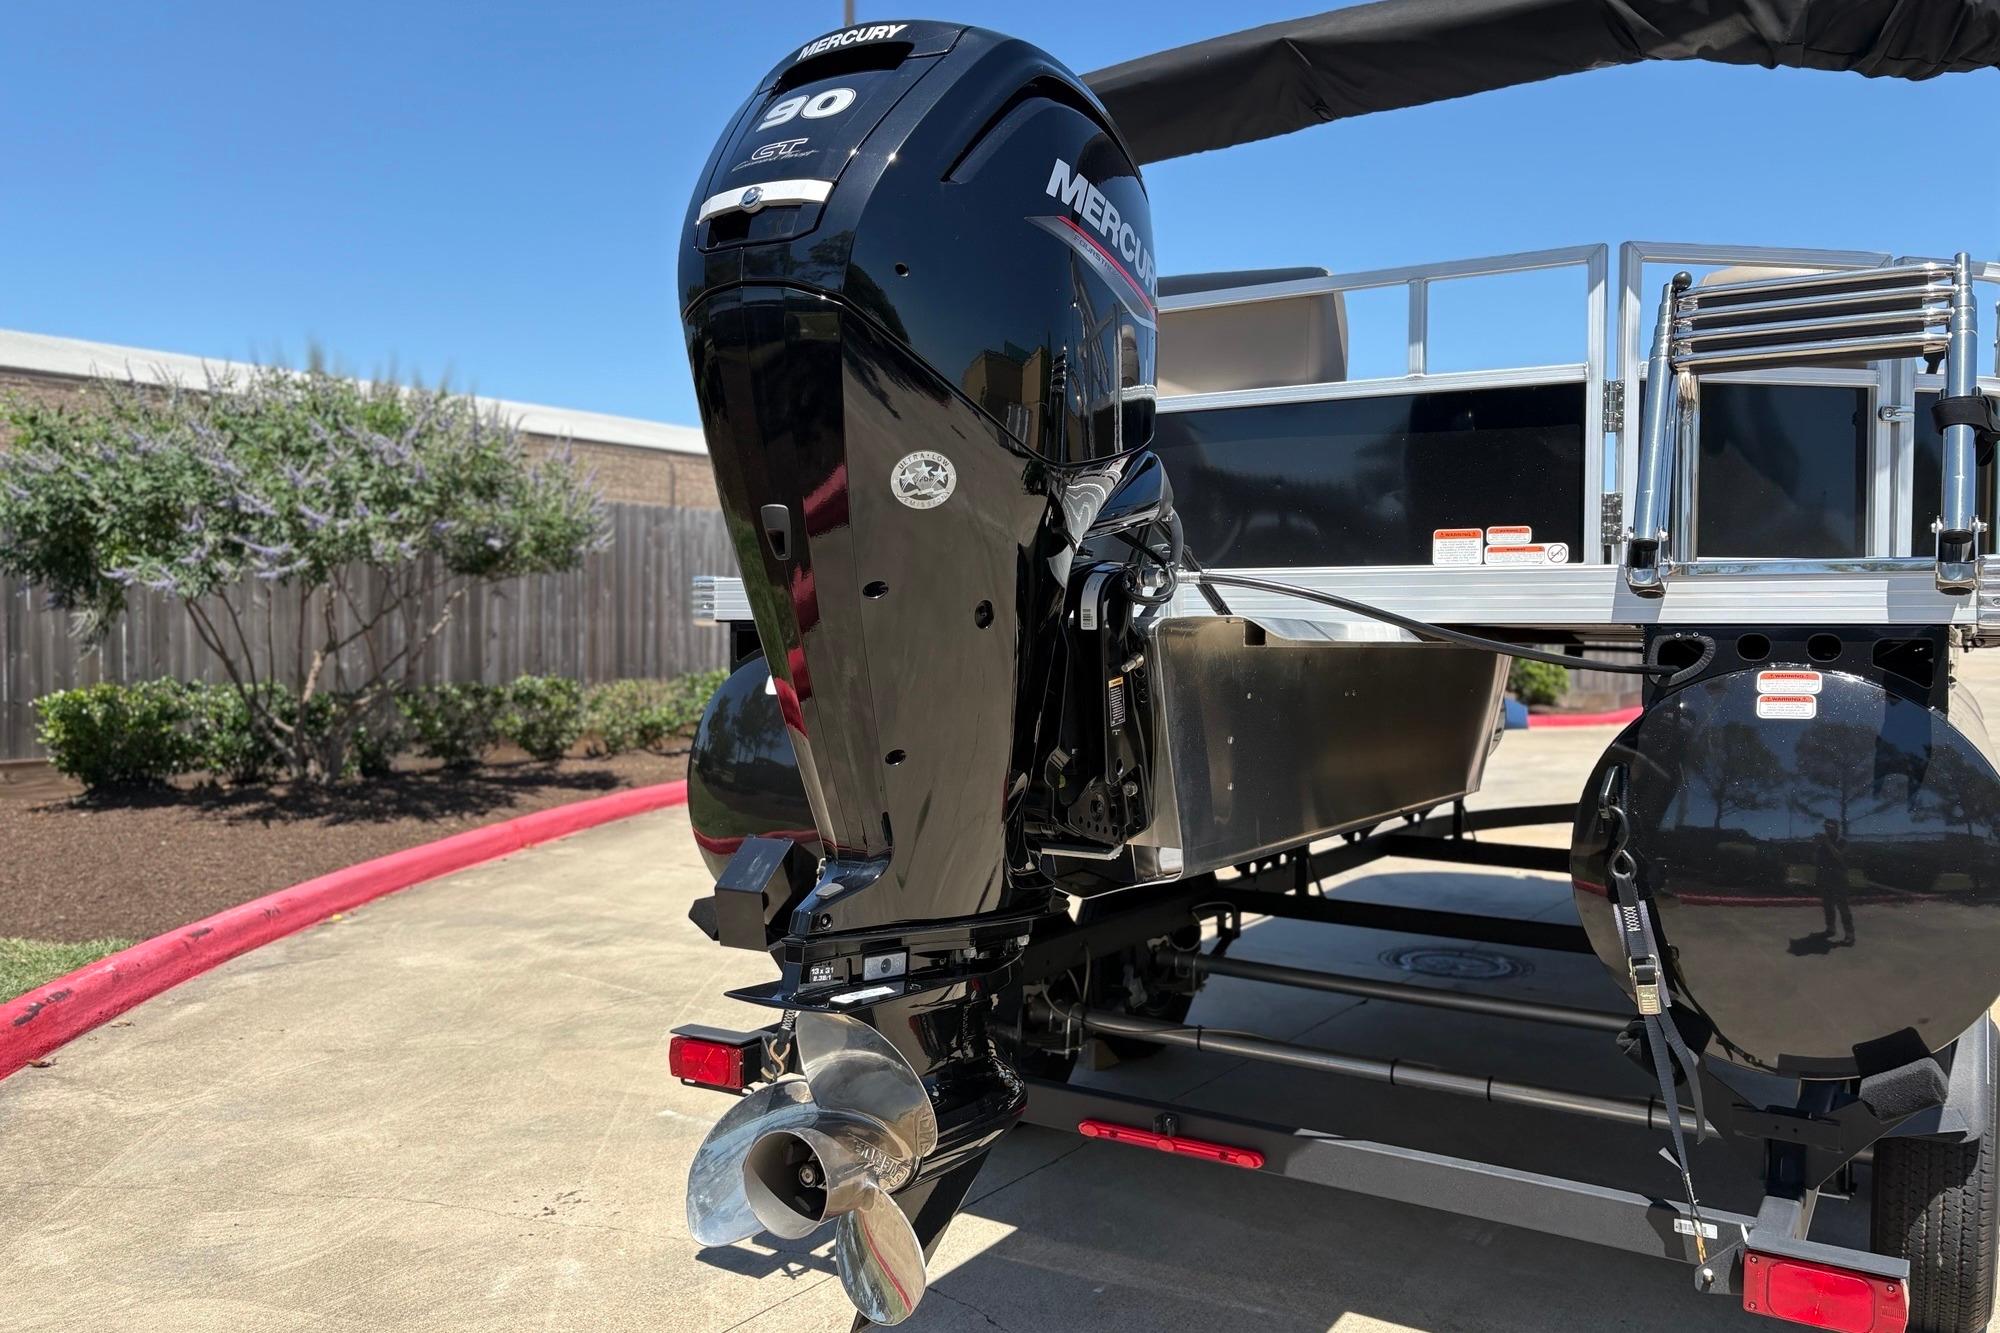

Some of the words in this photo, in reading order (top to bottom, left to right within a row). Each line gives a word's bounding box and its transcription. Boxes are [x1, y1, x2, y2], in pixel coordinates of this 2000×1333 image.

[796, 25, 907, 62] MERCURY
[756, 88, 857, 132] 90
[752, 137, 809, 160] GT
[1046, 158, 1157, 298] MERCUR
[898, 453, 925, 470] ULTRA
[932, 454, 949, 467] LOW
